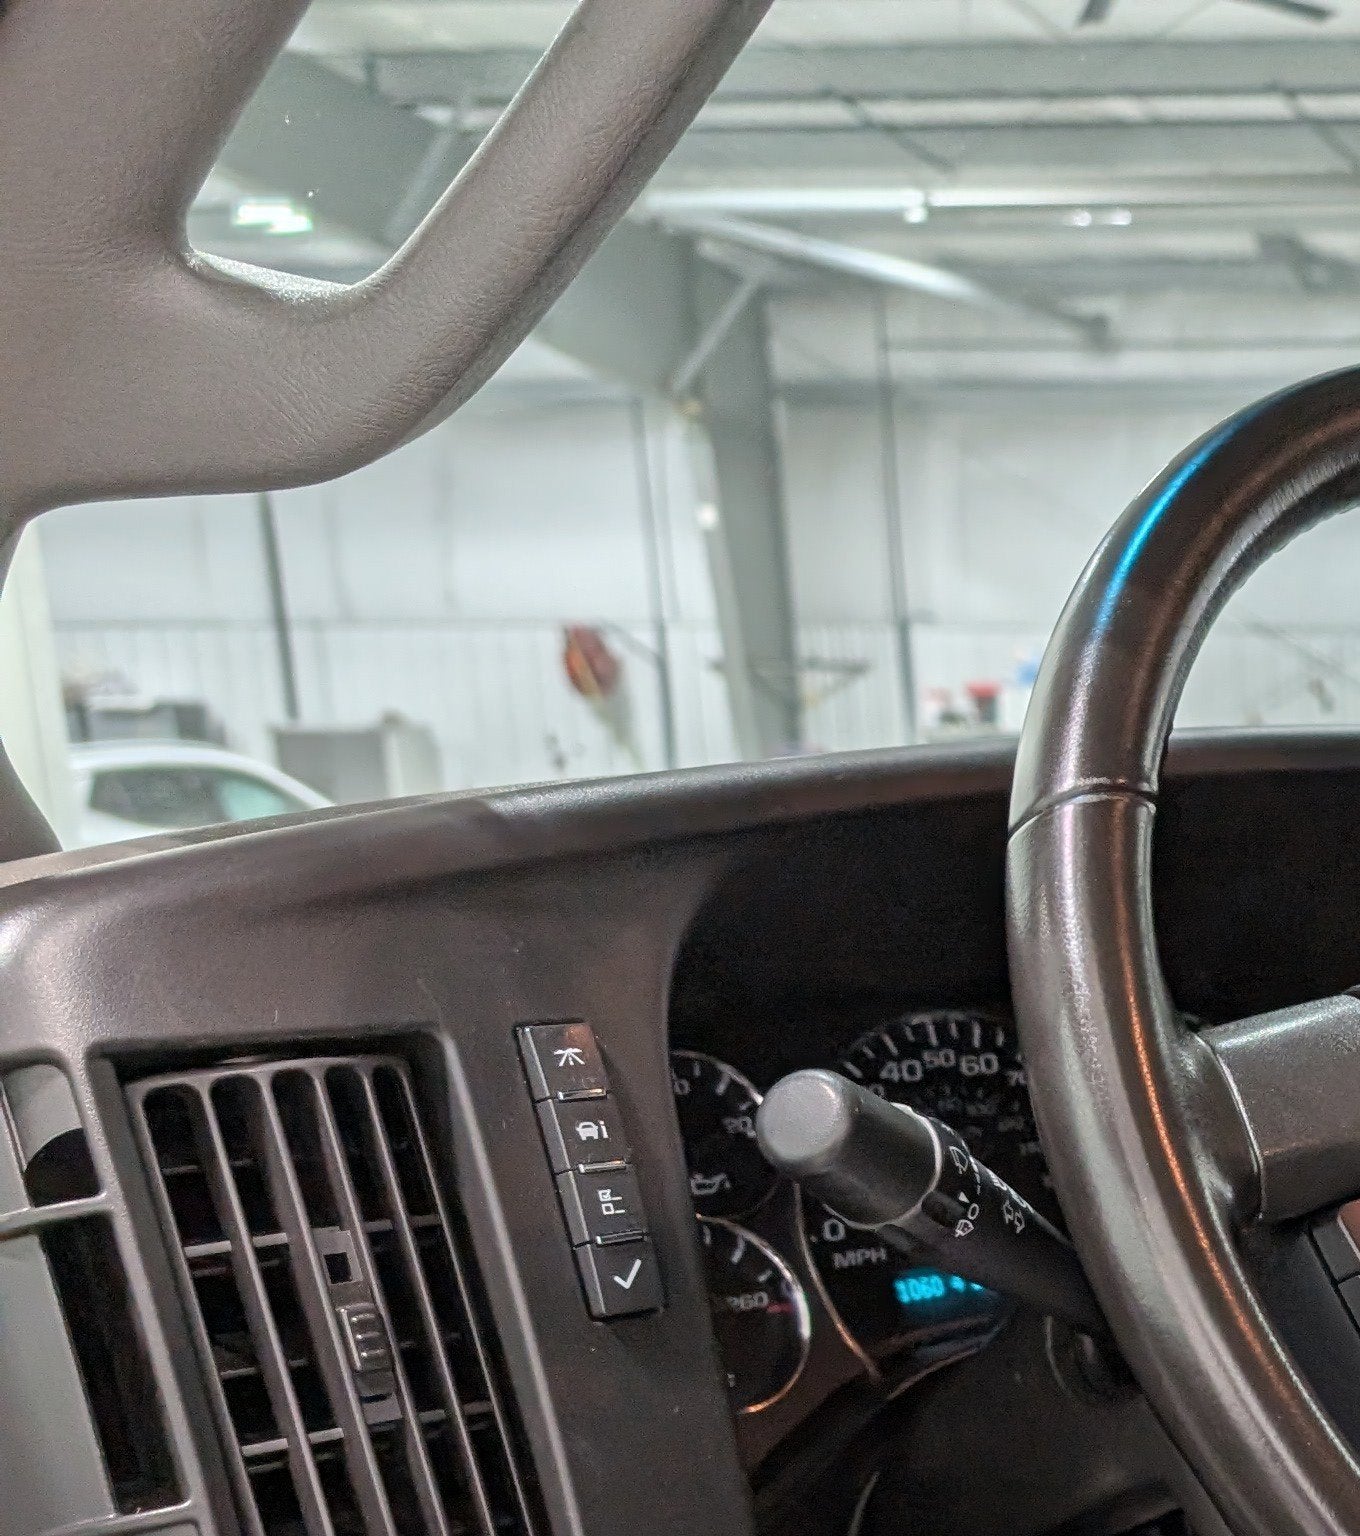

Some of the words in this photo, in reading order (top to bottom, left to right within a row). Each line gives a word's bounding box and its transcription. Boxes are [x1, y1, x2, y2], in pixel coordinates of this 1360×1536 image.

[879, 1059, 924, 1082] 40
[959, 1052, 999, 1076] 60
[822, 1218, 846, 1242] 0
[833, 1247, 887, 1269] MPH
